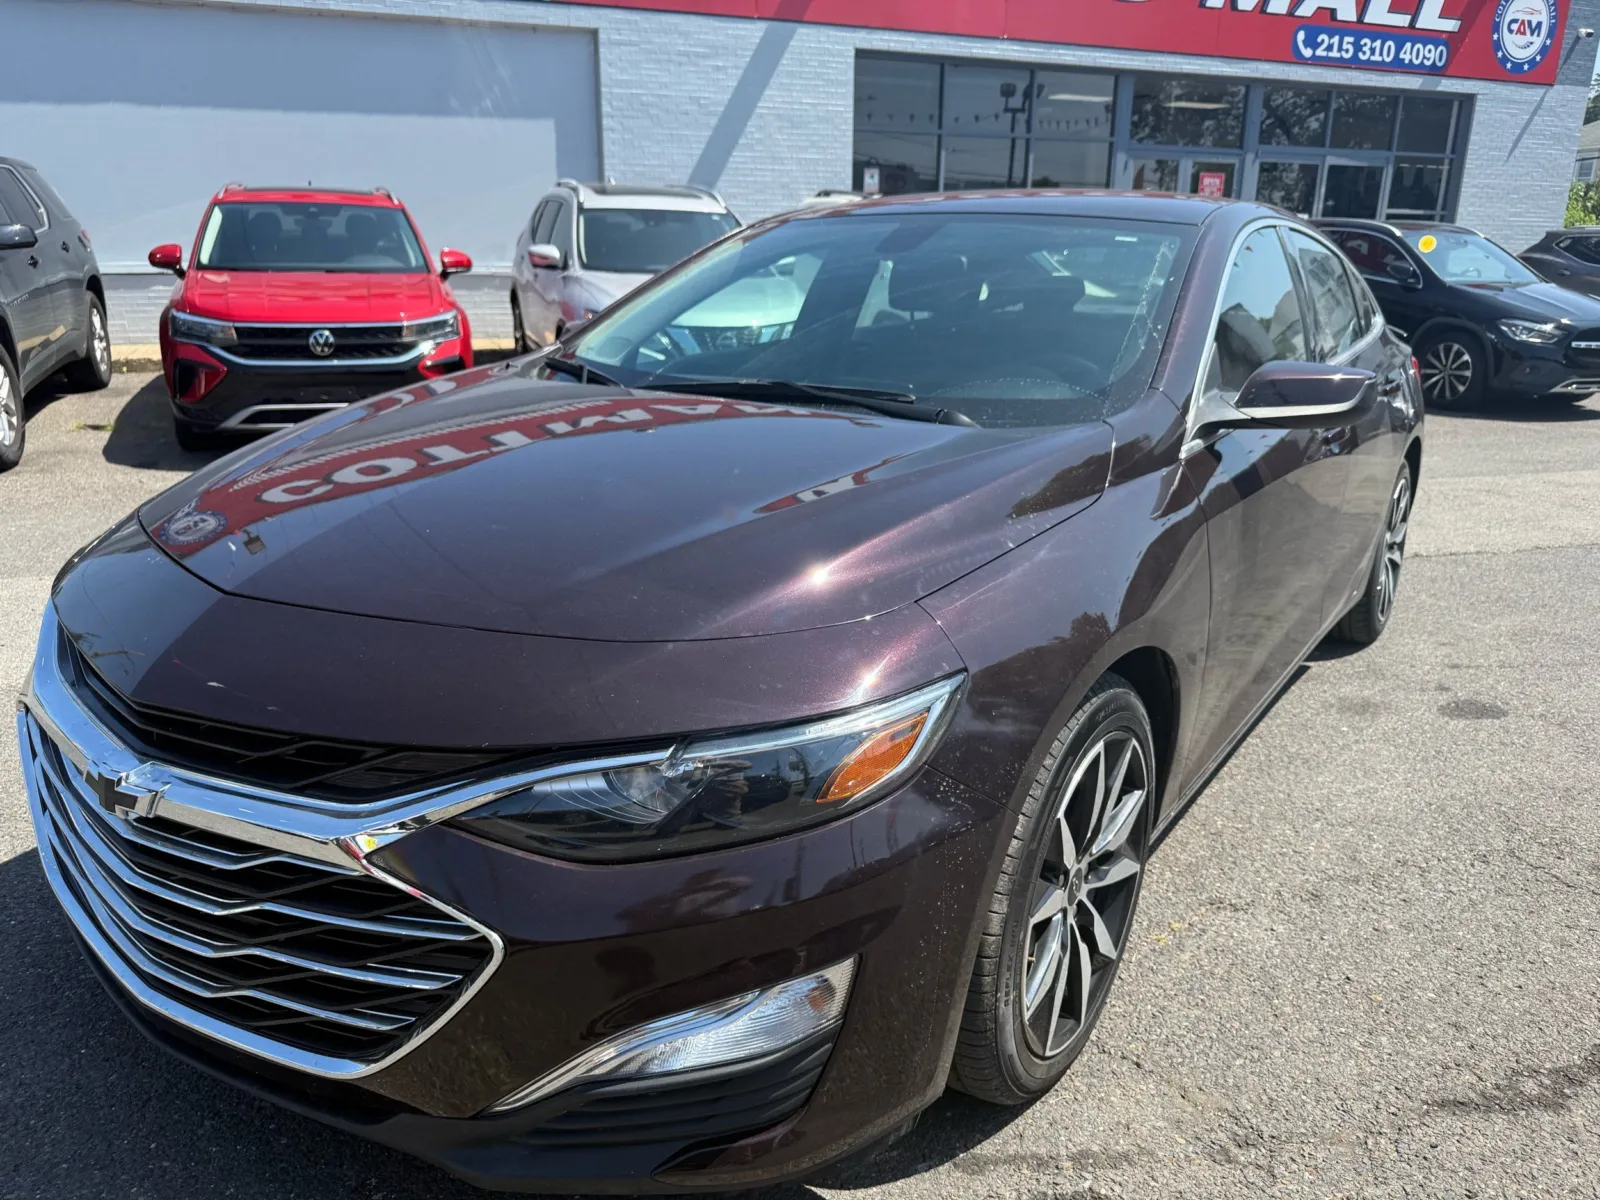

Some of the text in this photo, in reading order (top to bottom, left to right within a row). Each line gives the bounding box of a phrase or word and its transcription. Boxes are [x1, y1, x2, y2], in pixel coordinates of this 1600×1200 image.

[1200, 0, 1461, 32] ALL
[1507, 18, 1543, 37] CAM
[1315, 33, 1447, 67] 215 310 4090
